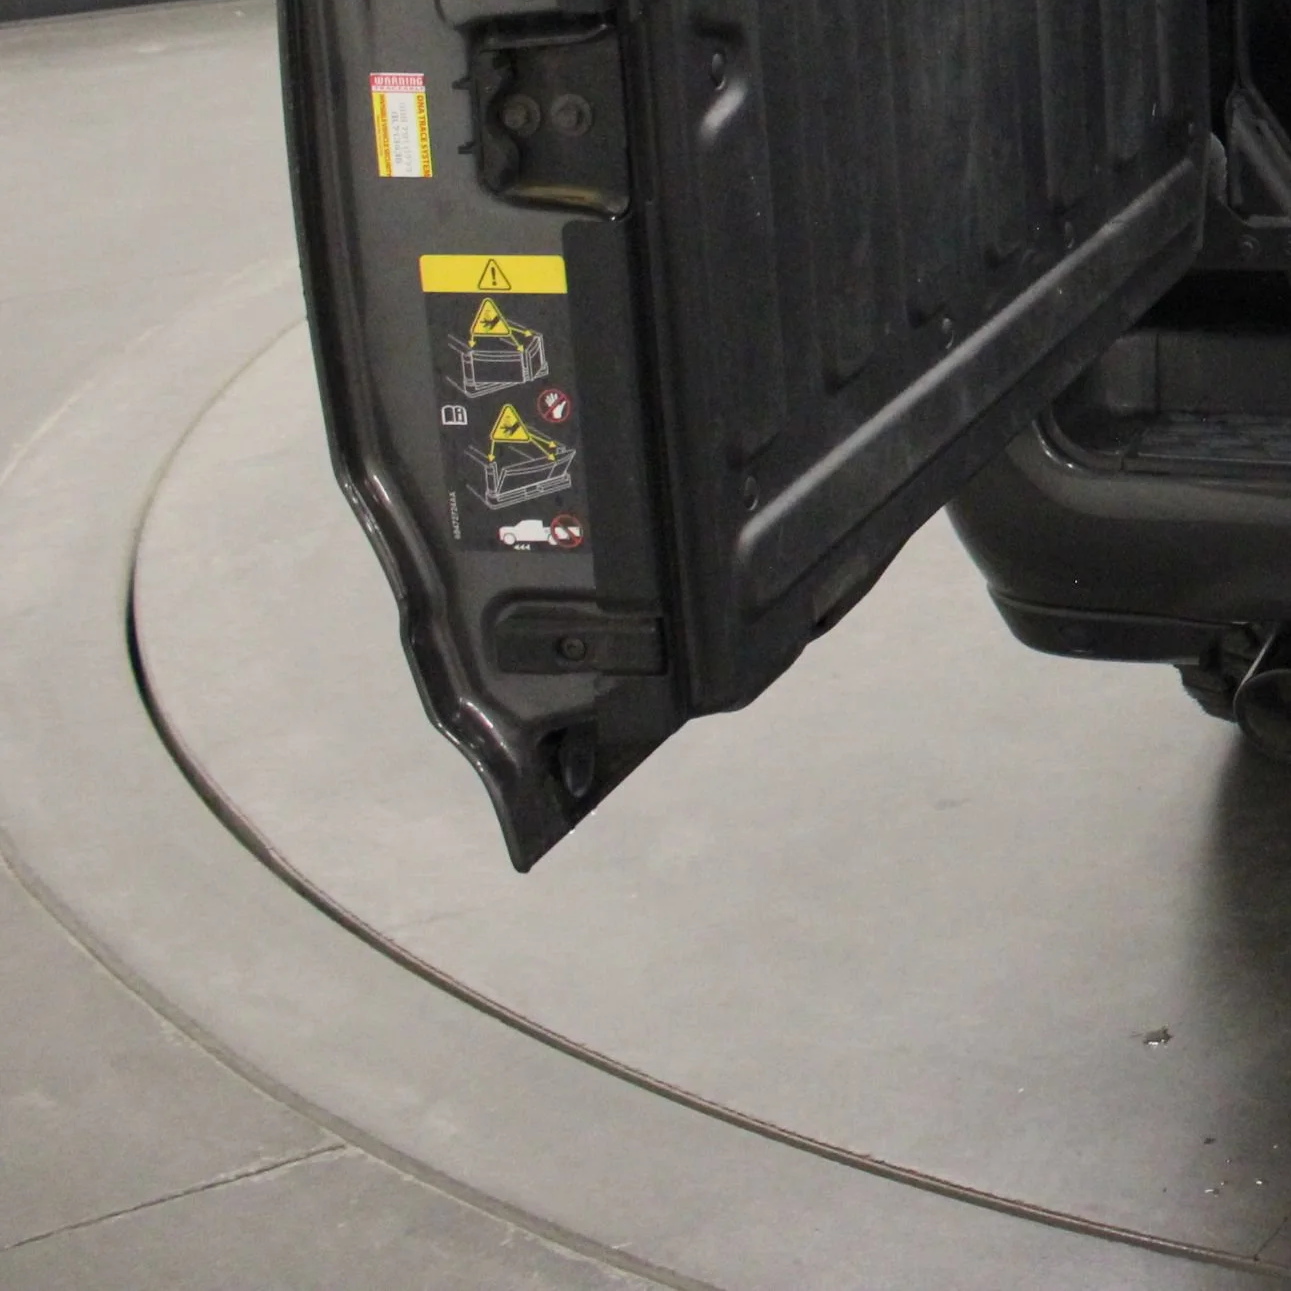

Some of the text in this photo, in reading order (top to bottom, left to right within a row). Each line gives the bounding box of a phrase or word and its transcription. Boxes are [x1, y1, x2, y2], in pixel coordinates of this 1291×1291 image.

[374, 75, 423, 86] WARNING
[416, 95, 431, 177] DNA TRACE SYSTEM
